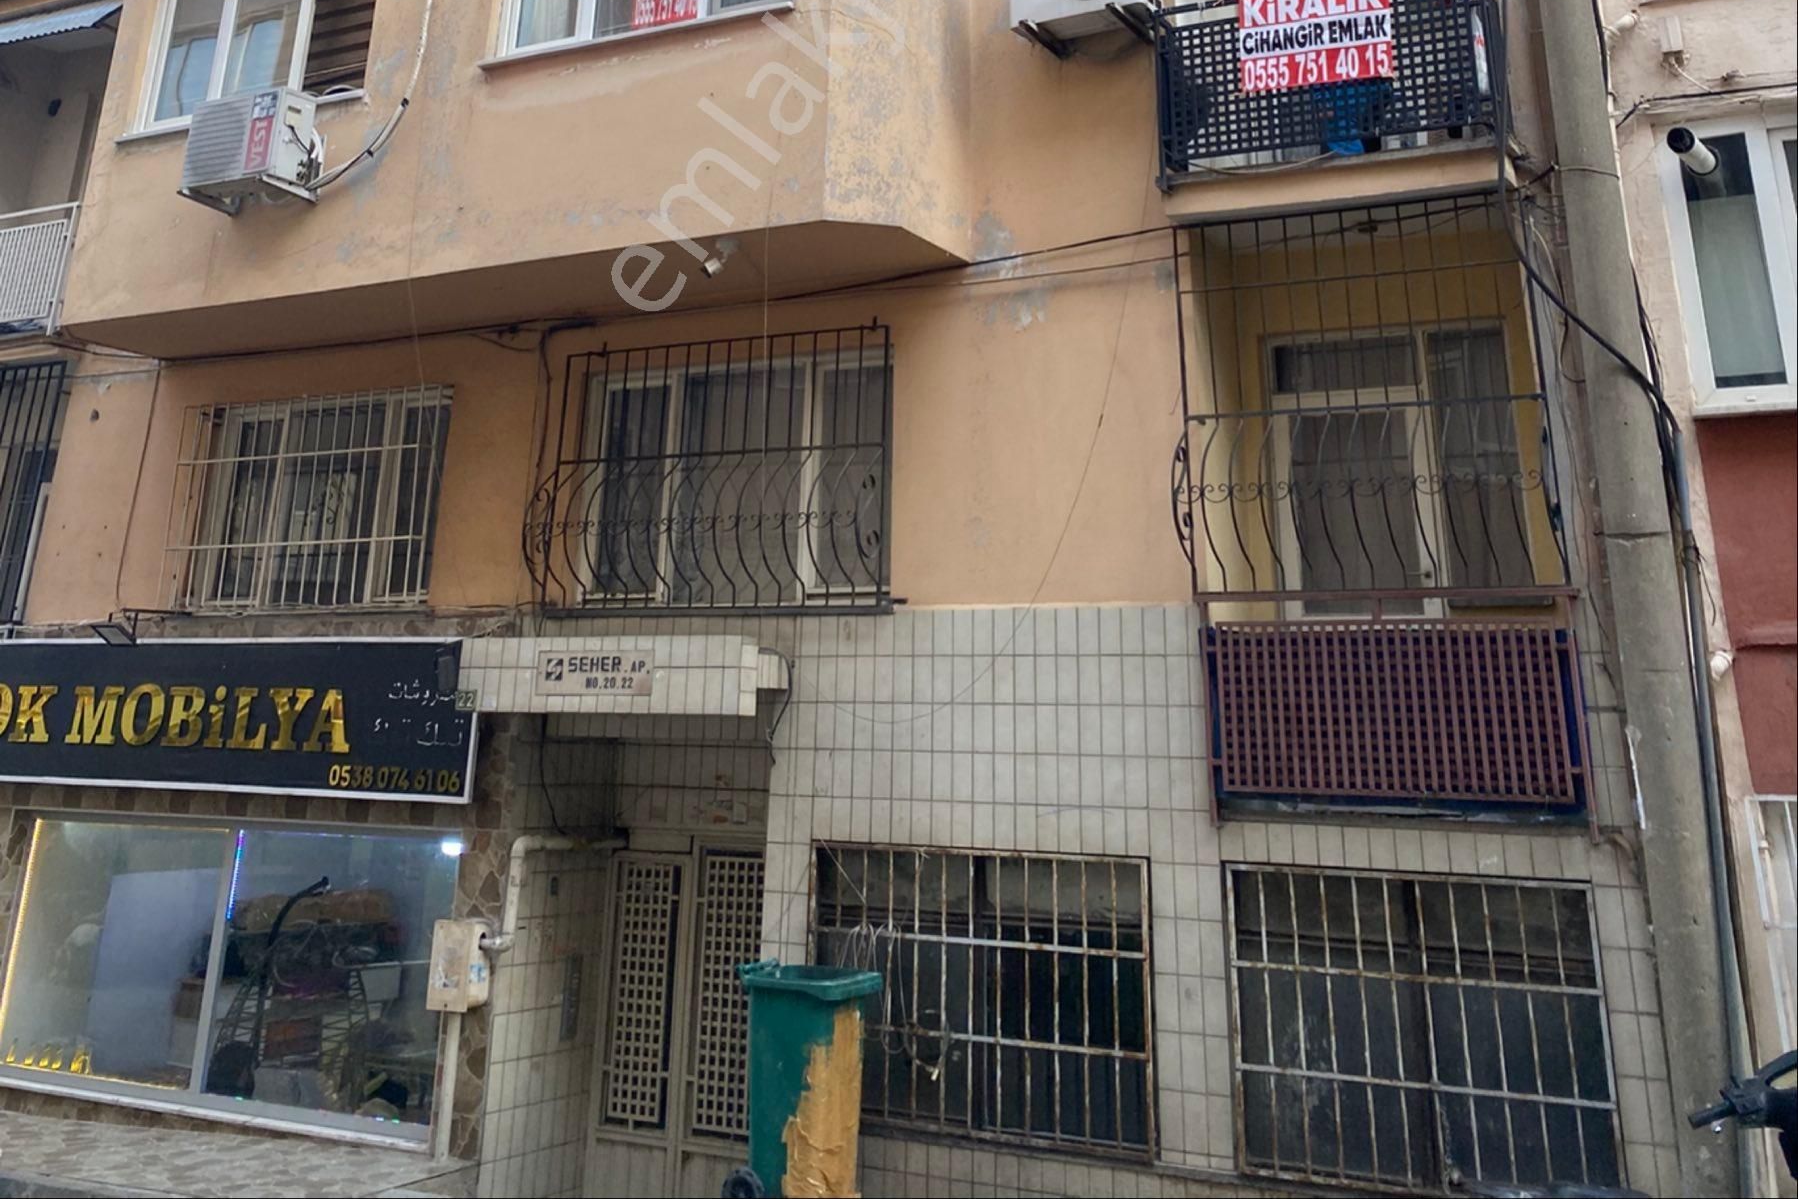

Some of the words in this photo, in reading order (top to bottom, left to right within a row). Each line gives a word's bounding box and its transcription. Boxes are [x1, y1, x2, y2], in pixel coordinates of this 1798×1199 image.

[1328, 14, 1388, 45] EMLAK
[1244, 56, 1289, 90] 0555
[1295, 51, 1329, 85] 751
[1335, 48, 1359, 80] 40
[1365, 44, 1390, 76] 15
[457, 692, 475, 708] 22
[329, 764, 374, 788] 0538
[377, 766, 410, 791] 074
[414, 768, 434, 792] 61
[436, 769, 461, 793] 06
